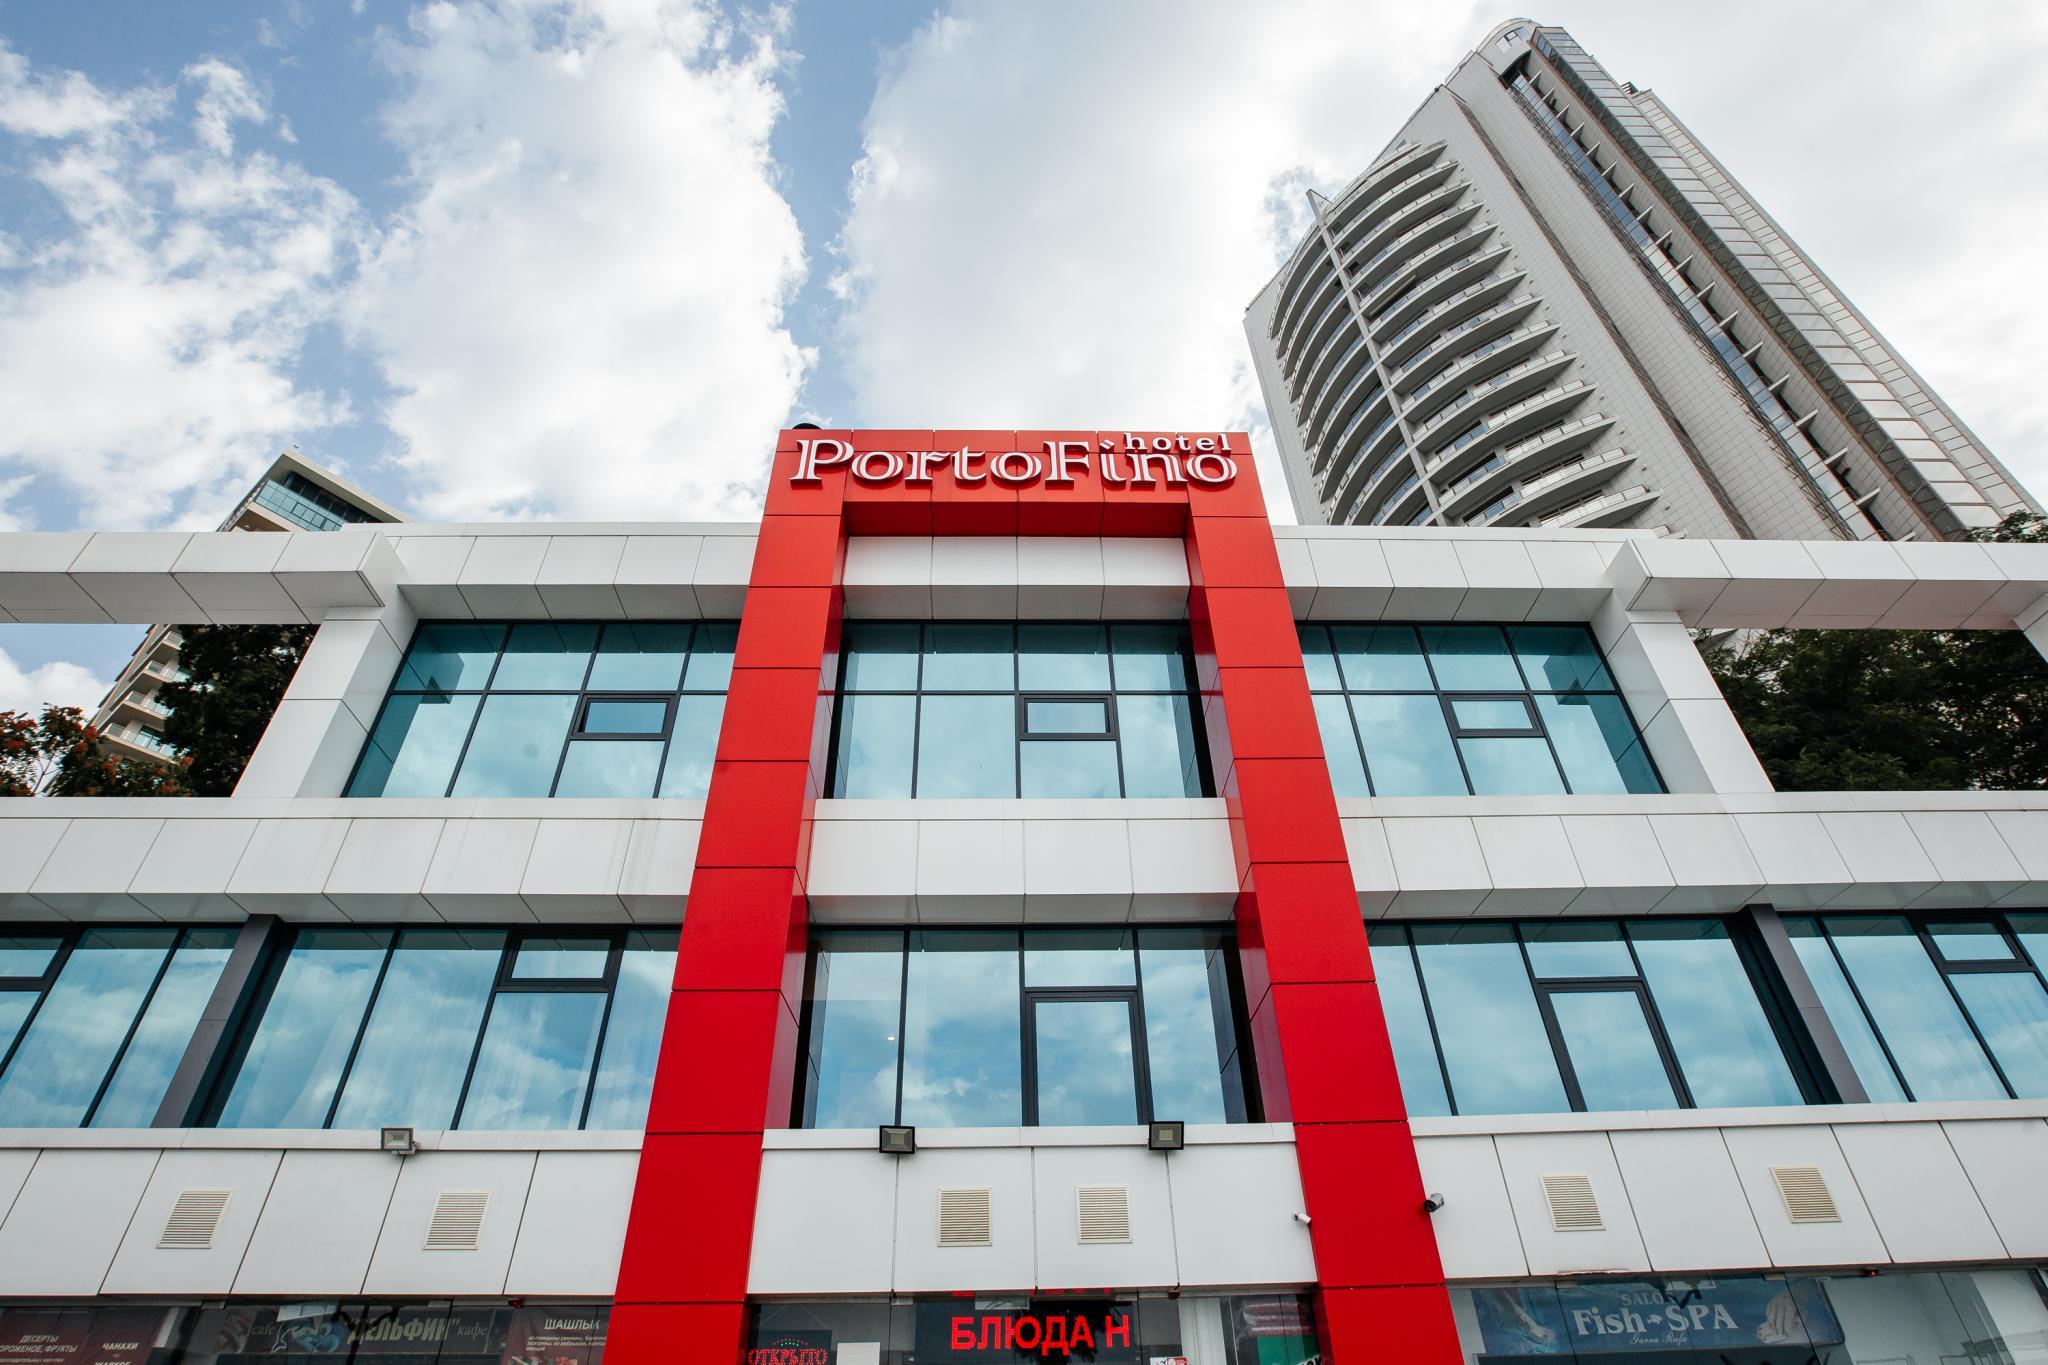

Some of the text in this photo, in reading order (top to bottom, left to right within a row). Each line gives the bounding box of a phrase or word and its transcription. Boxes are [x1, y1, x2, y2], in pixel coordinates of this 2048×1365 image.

[1123, 432, 1232, 452] hotel
[789, 438, 1239, 485] PortoFino
[457, 1322, 488, 1340] кафе
[1571, 1303, 1739, 1335] Fish SPA
[18, 1334, 59, 1344] ДЕСЕРТЫ
[951, 1316, 1095, 1356] БЛЮДА
